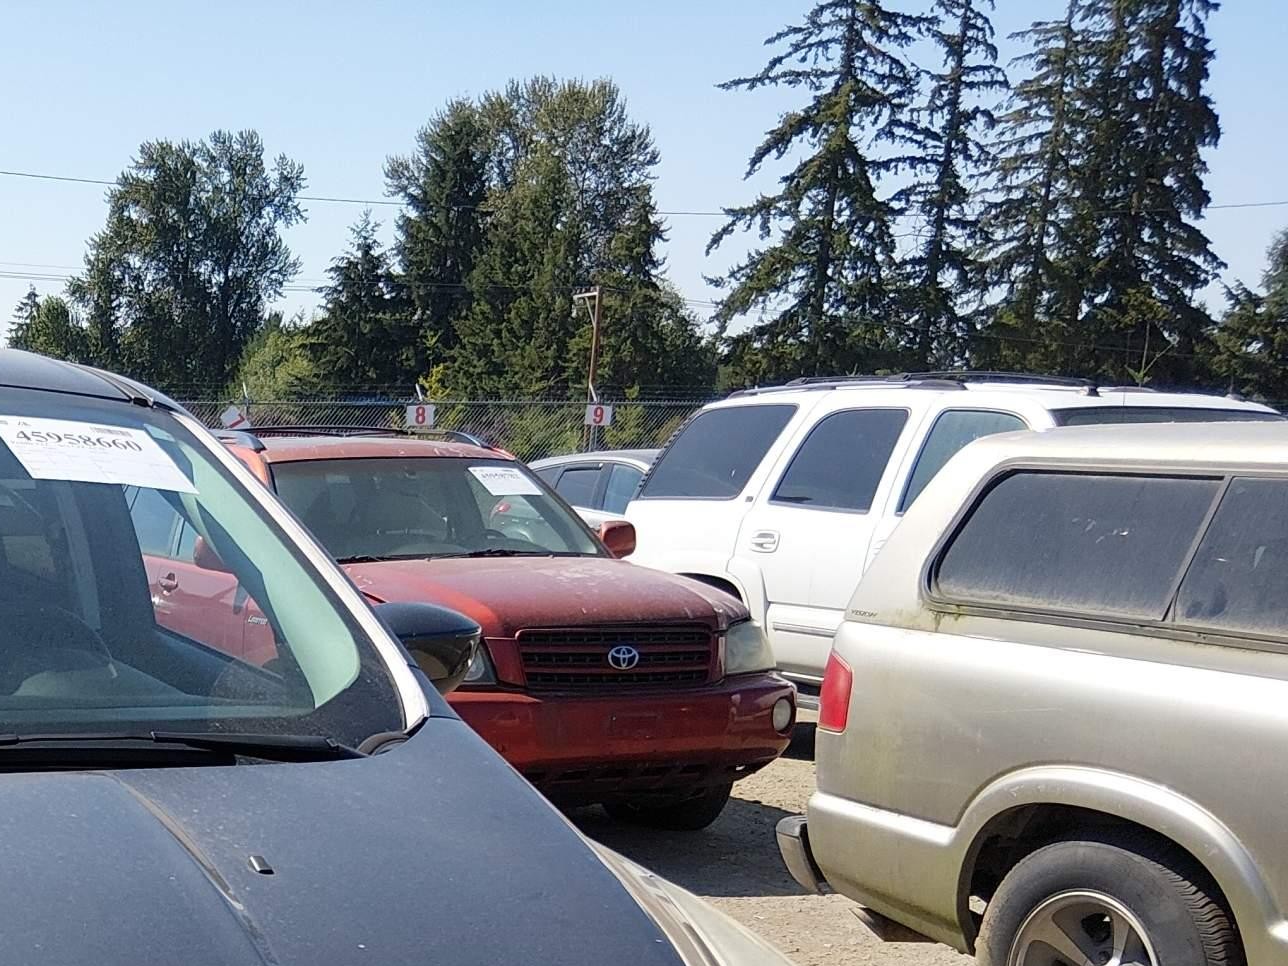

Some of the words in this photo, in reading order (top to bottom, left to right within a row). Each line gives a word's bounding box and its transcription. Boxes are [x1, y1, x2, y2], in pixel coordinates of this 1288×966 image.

[415, 406, 426, 425] 8
[593, 406, 605, 425] 9
[16, 430, 143, 452] 45958660
